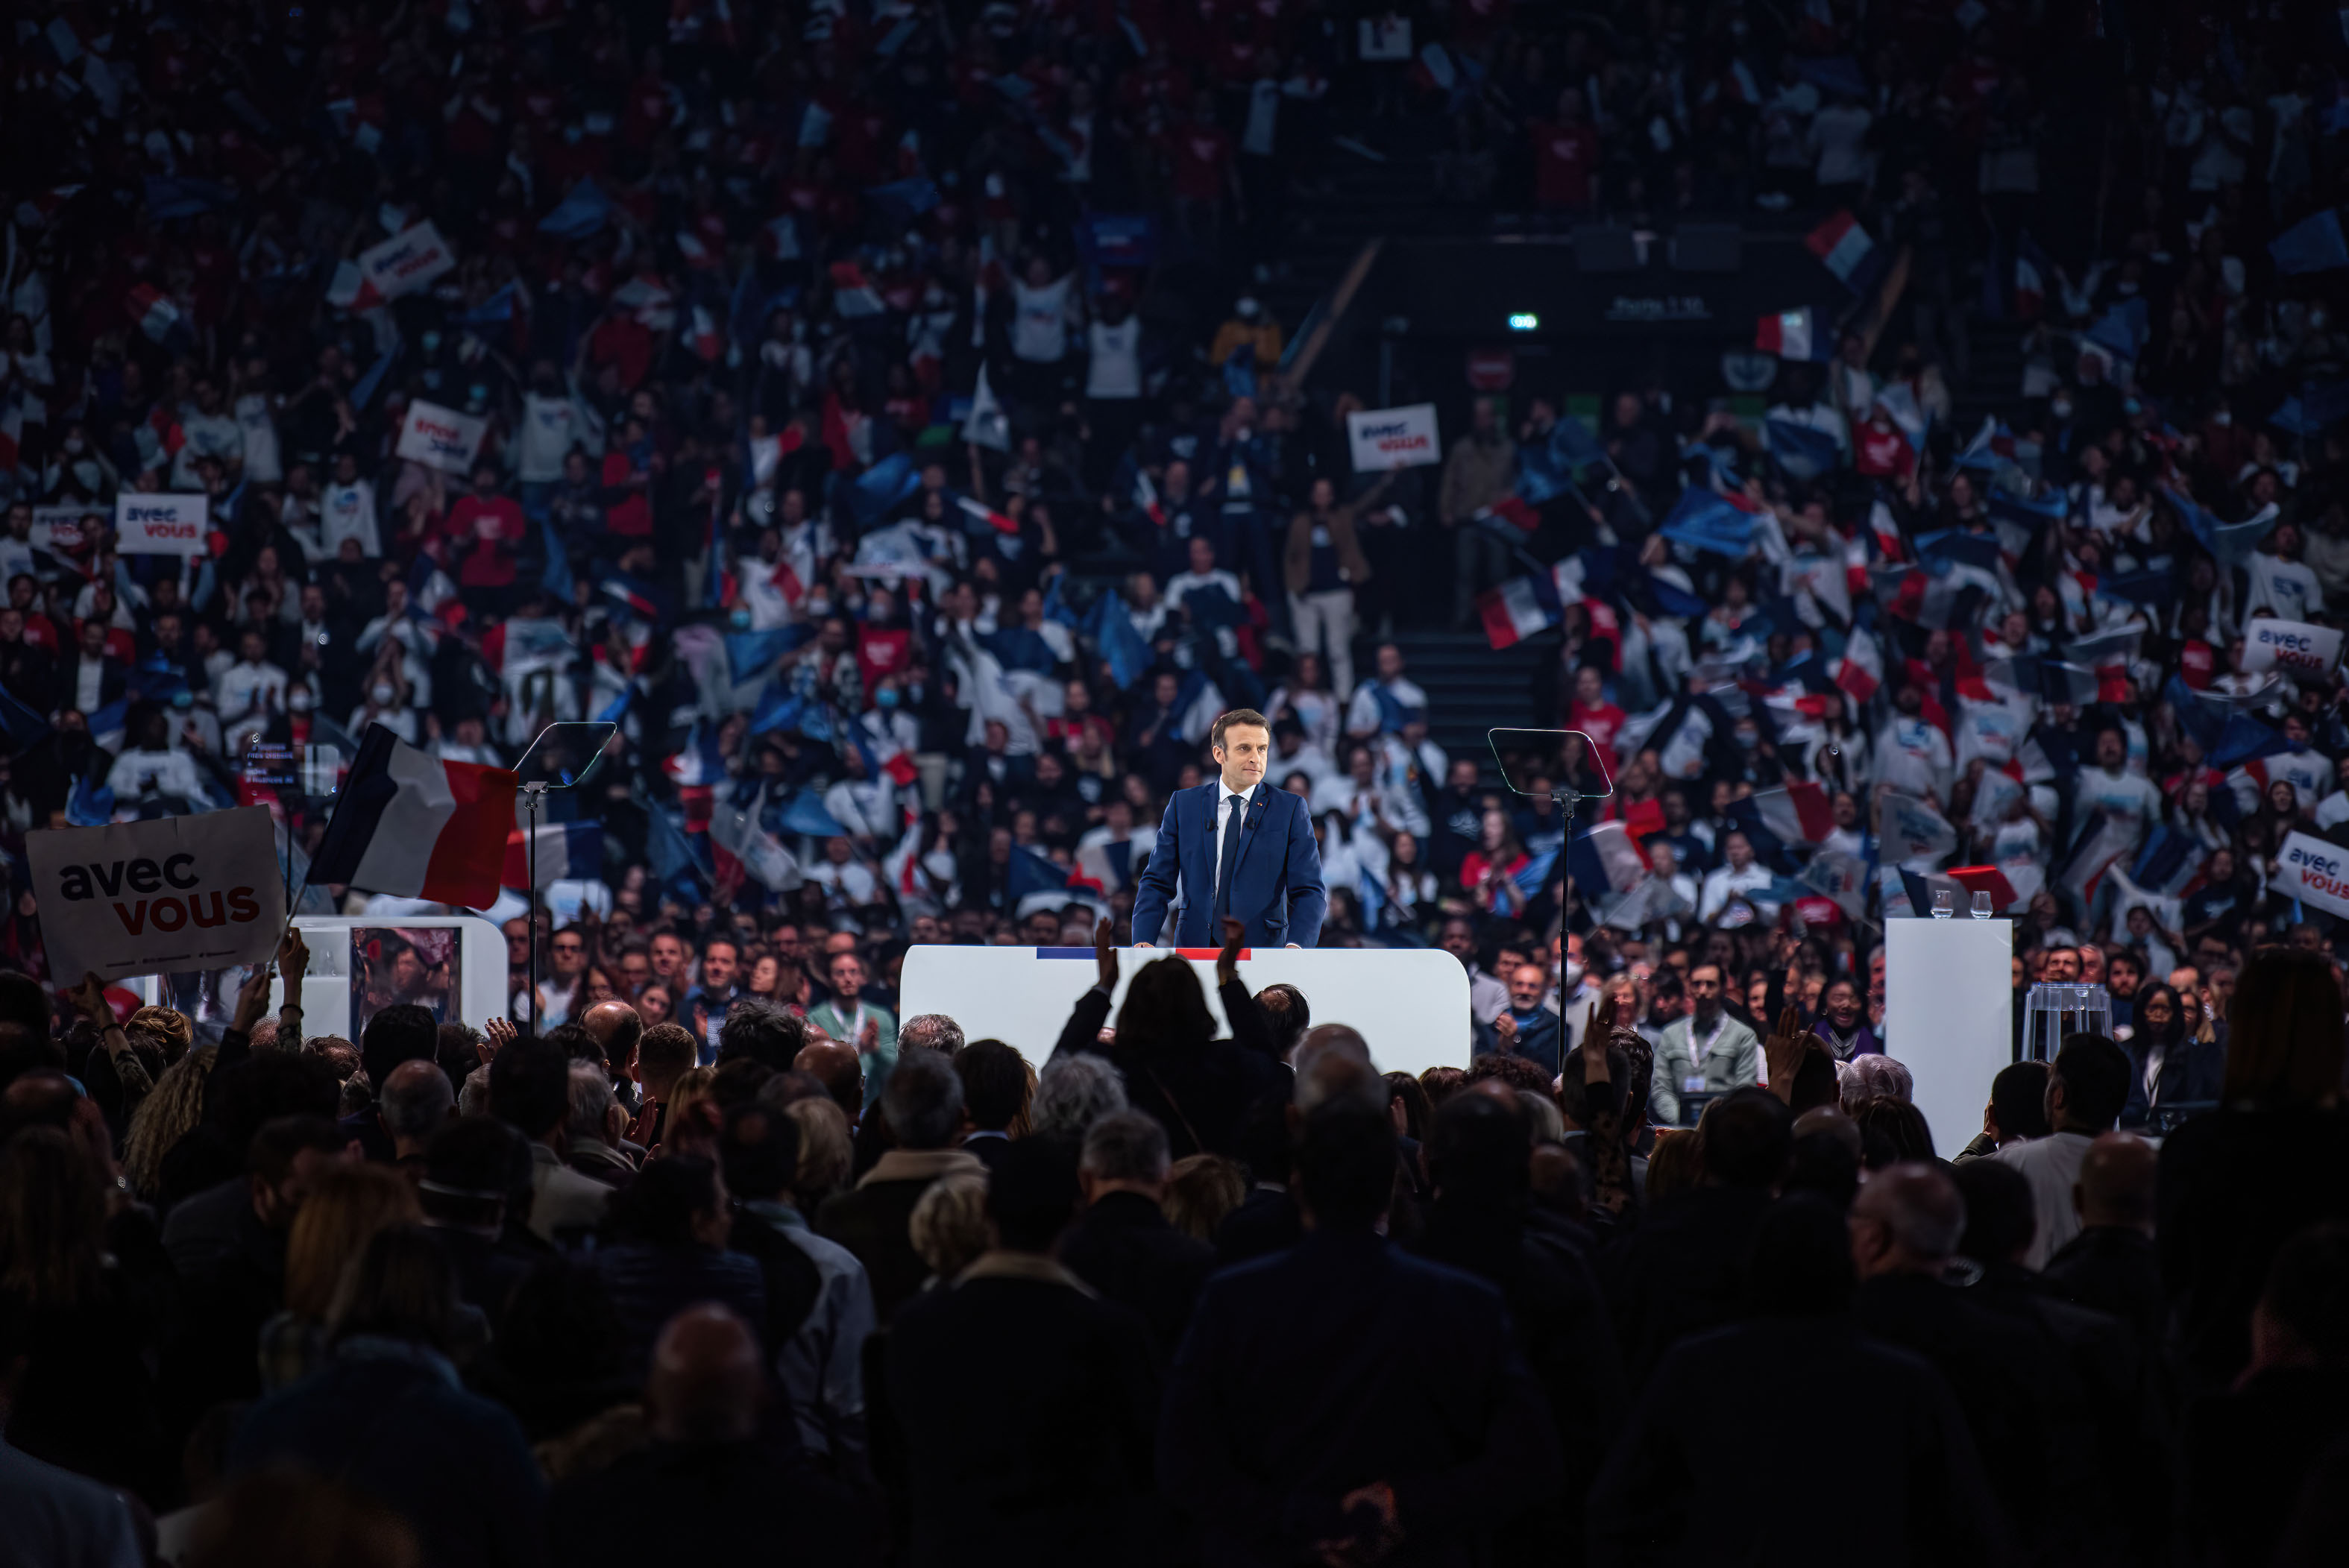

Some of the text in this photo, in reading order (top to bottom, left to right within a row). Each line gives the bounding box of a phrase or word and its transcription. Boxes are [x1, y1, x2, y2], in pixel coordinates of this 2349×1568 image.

[127, 507, 177, 521] avec
[144, 523, 197, 538] vous
[2259, 629, 2311, 652] avec
[2276, 647, 2324, 670] vous
[2289, 848, 2340, 876] avec
[59, 854, 199, 901] avec
[2301, 869, 2349, 900] vous
[113, 887, 260, 936] vous
